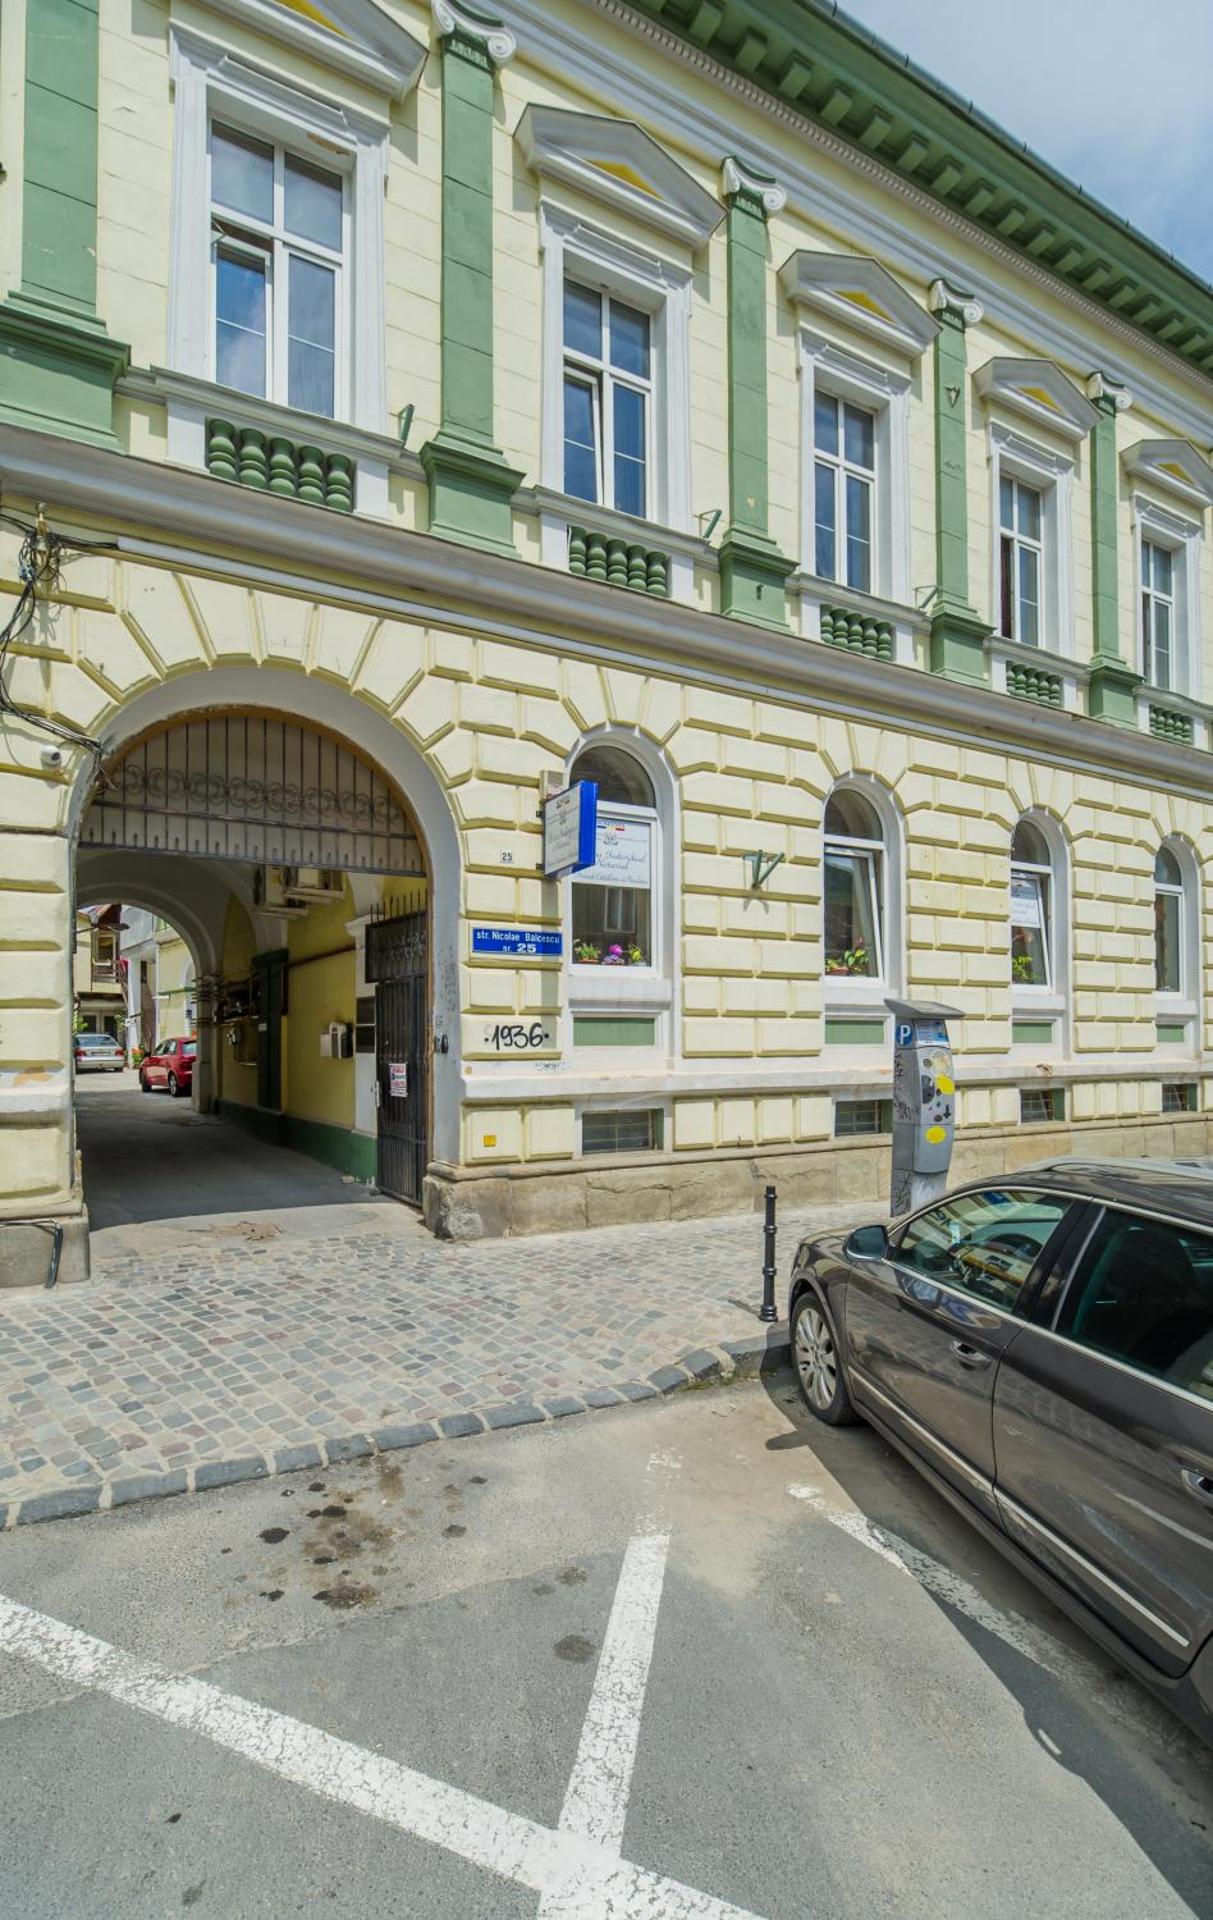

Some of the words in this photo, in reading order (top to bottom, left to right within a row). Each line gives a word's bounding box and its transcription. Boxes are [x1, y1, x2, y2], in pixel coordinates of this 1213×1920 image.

[492, 931, 520, 941] Nicolae
[516, 943, 537, 953] 25
[900, 1024, 911, 1045] P
